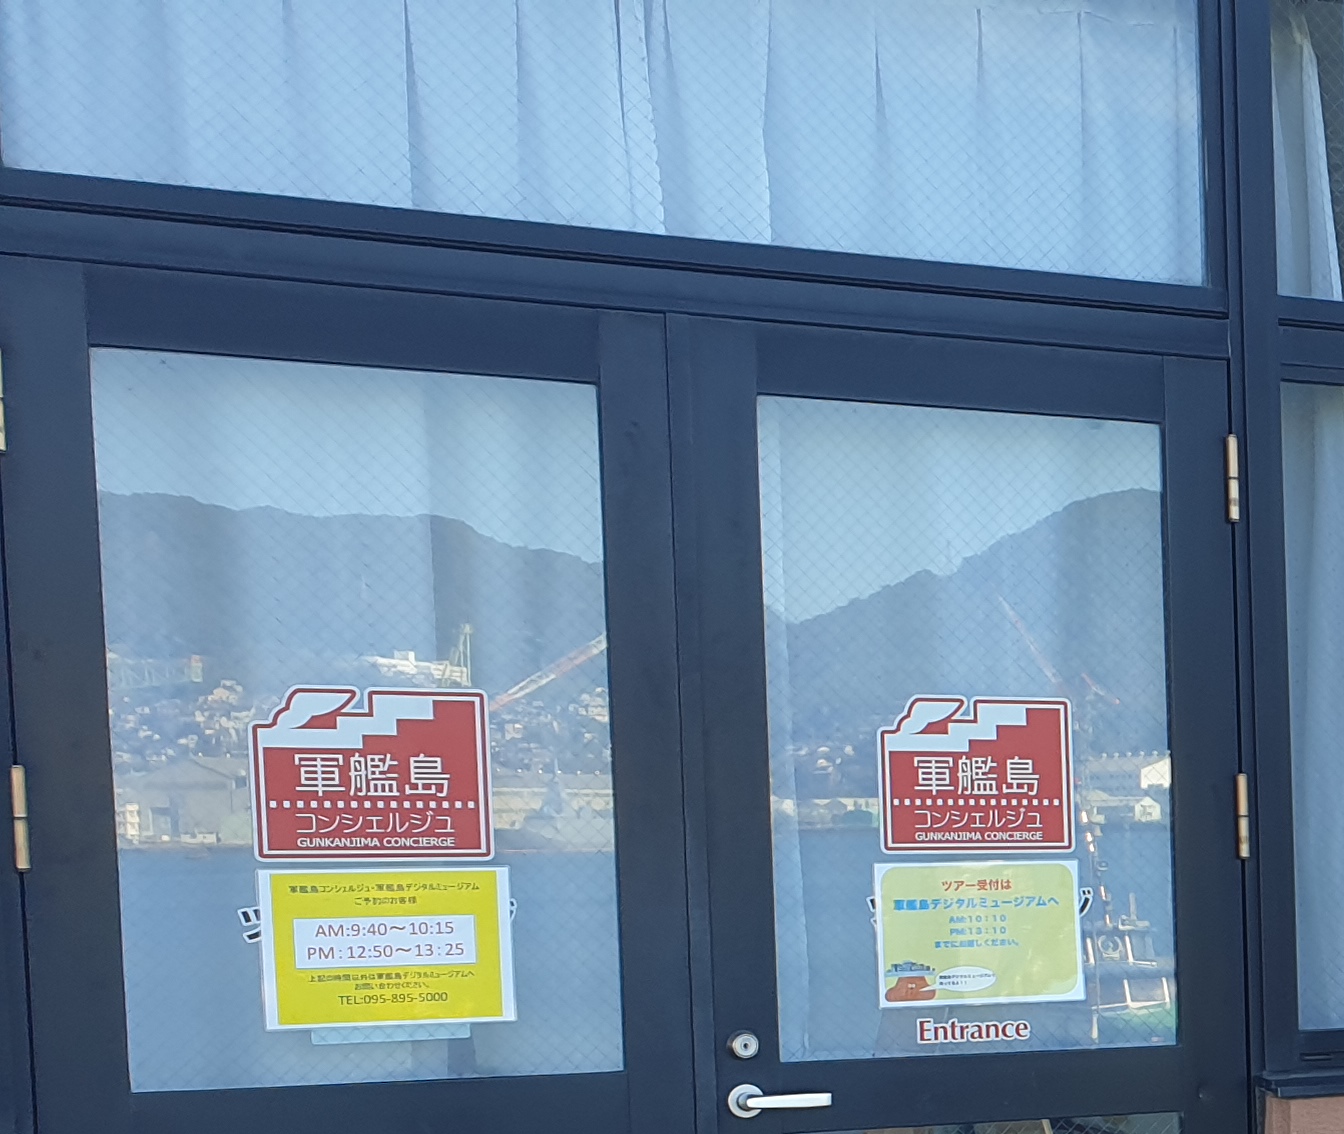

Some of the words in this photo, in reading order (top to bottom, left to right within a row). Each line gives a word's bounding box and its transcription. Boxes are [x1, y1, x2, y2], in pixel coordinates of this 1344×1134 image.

[294, 752, 450, 797] 軍艦島
[913, 755, 1040, 796] 軍艦島
[295, 811, 455, 833] コンシェルジュ
[914, 807, 1043, 828] コンシェルジュ
[297, 837, 380, 848] GUNKANJIMA
[383, 837, 455, 847] CONCIERGE
[915, 831, 982, 841] GUNKANJIMA
[985, 831, 1043, 841] CONCIERGE
[941, 879, 1012, 891] ツアー受付は
[354, 896, 417, 906] ご予約のお客様
[893, 896, 1059, 911] 軍艦島デジタルミュージアムへ
[338, 991, 449, 1006] TEL:095-895-5000
[918, 1020, 1030, 1042] Entrance
